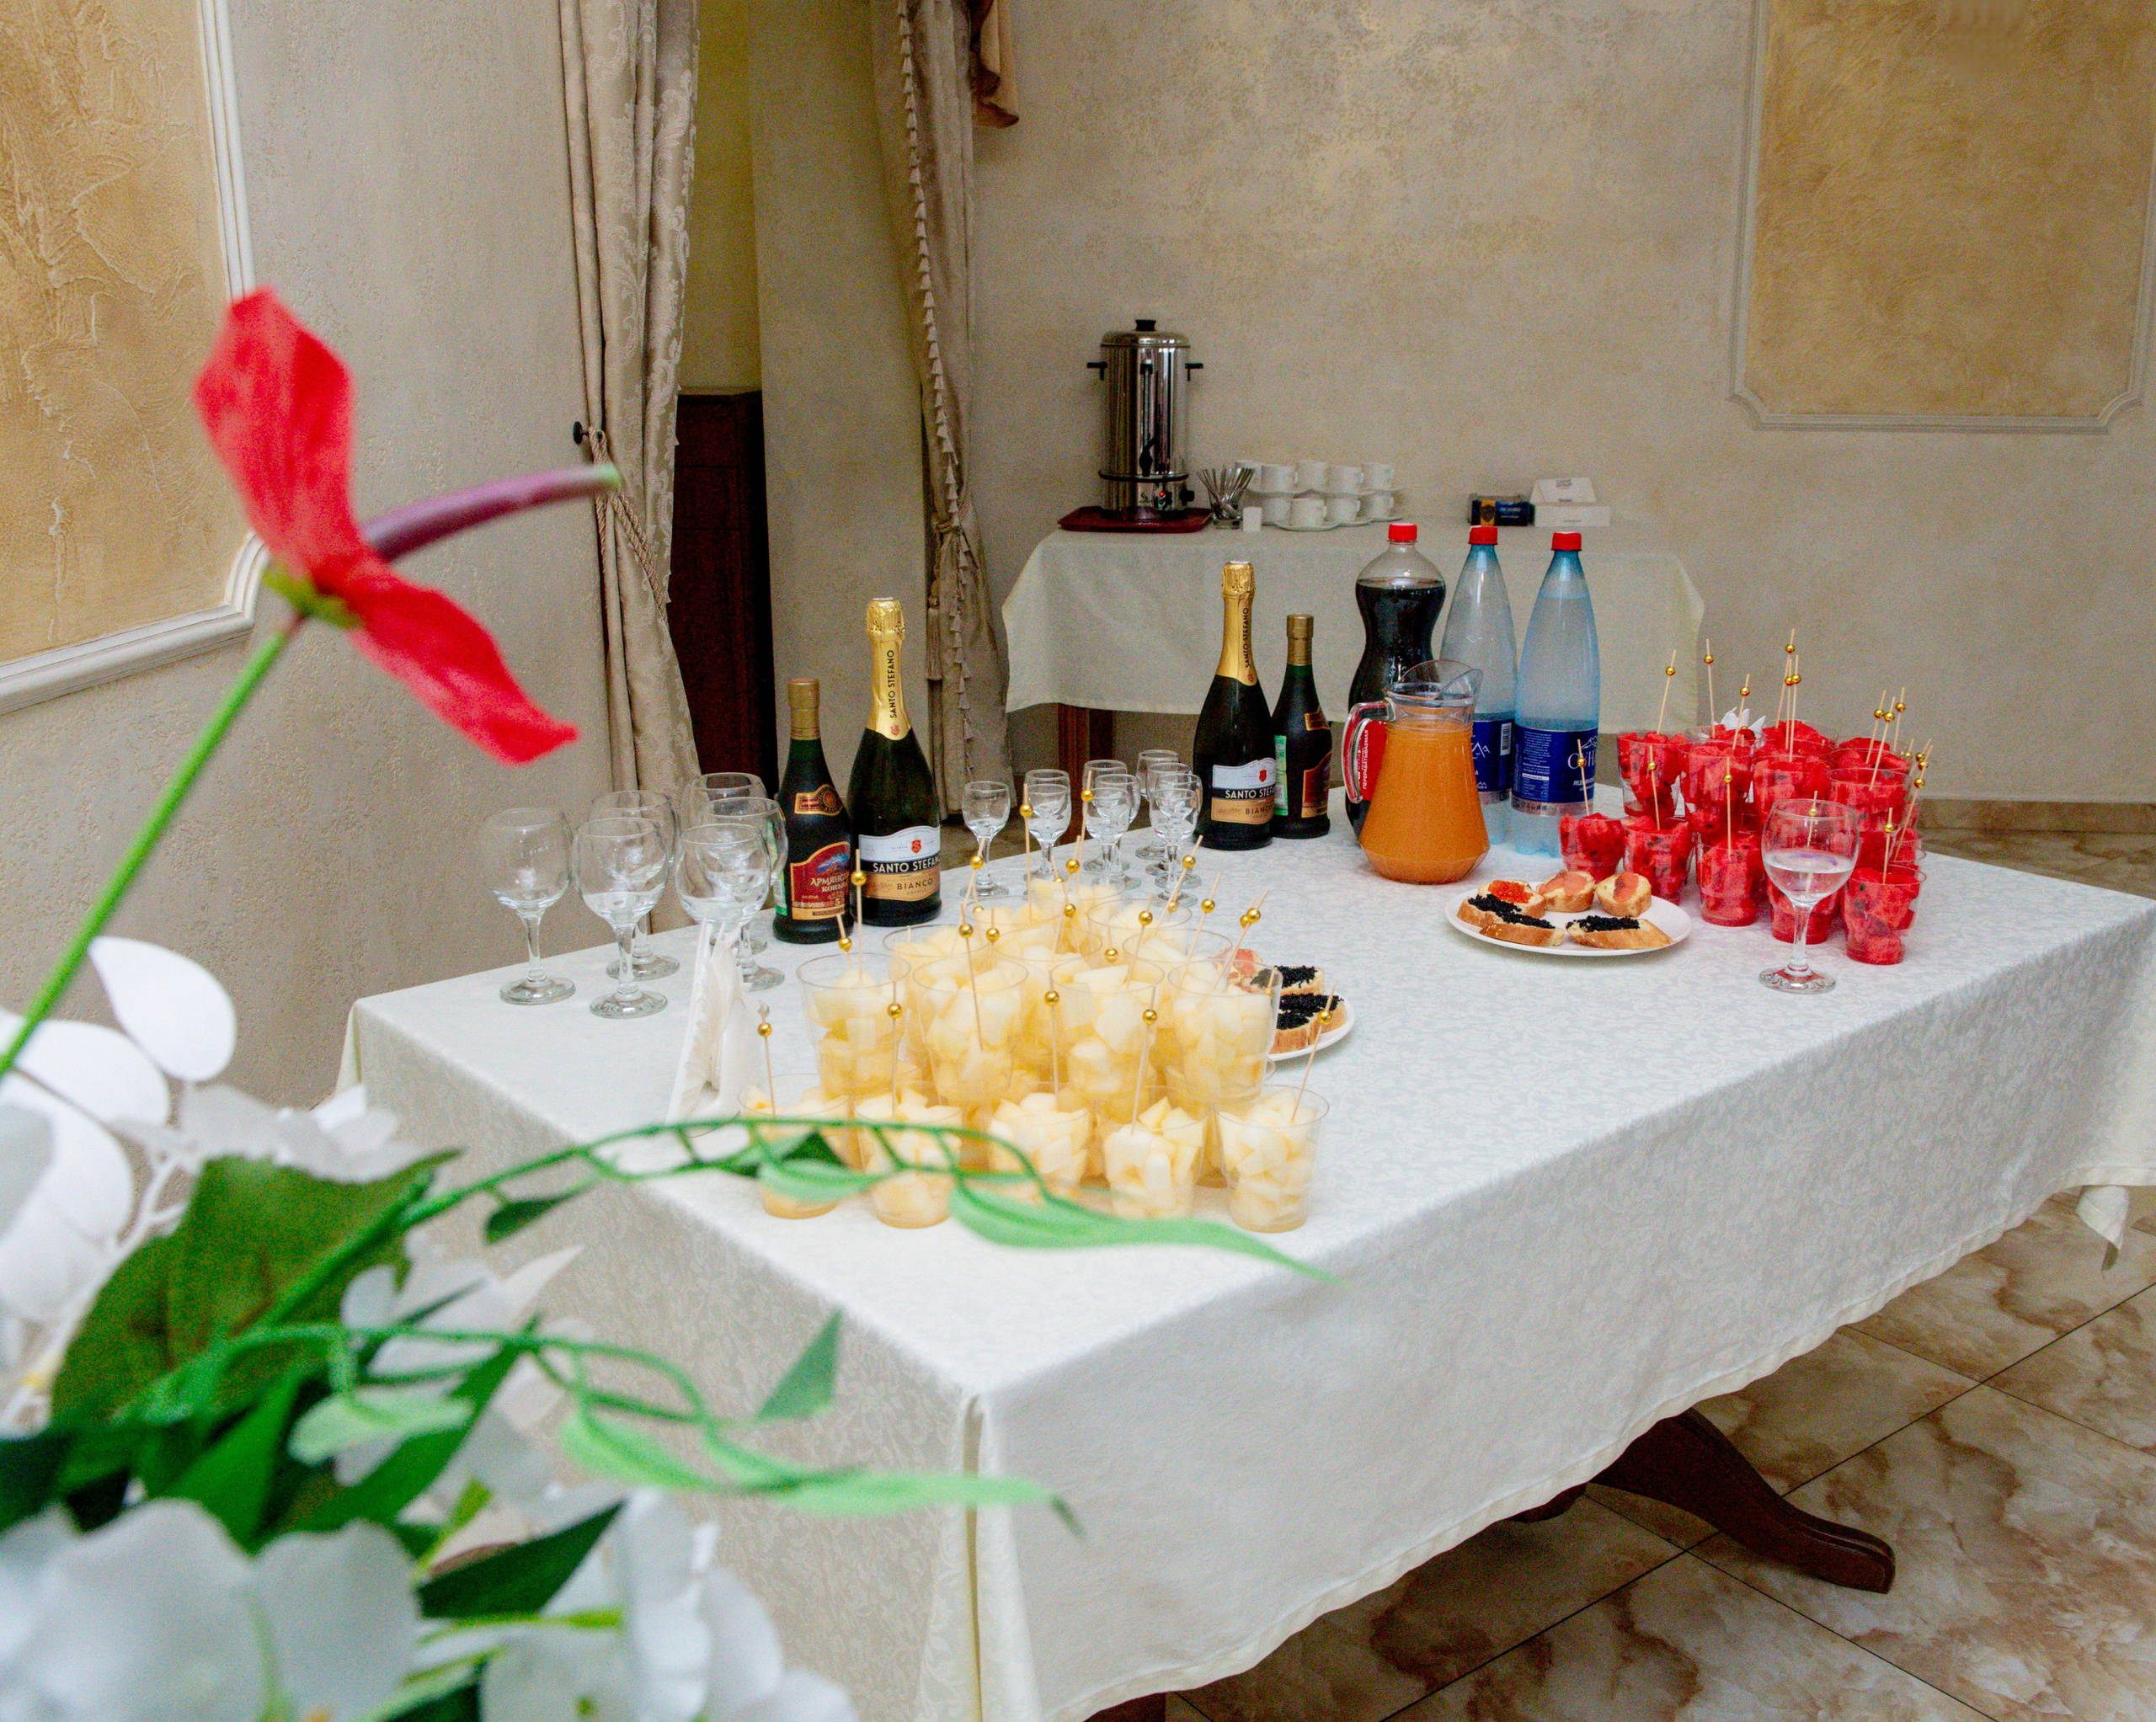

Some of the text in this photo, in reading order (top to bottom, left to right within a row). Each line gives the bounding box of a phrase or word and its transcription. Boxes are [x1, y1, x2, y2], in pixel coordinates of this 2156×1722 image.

[1243, 643, 1251, 668] SANTO
[887, 649, 897, 718] SANTO STEFANO
[1225, 790, 1257, 798] SANTO
[873, 862, 910, 873] SANTO
[897, 877, 933, 890] BIANCO
